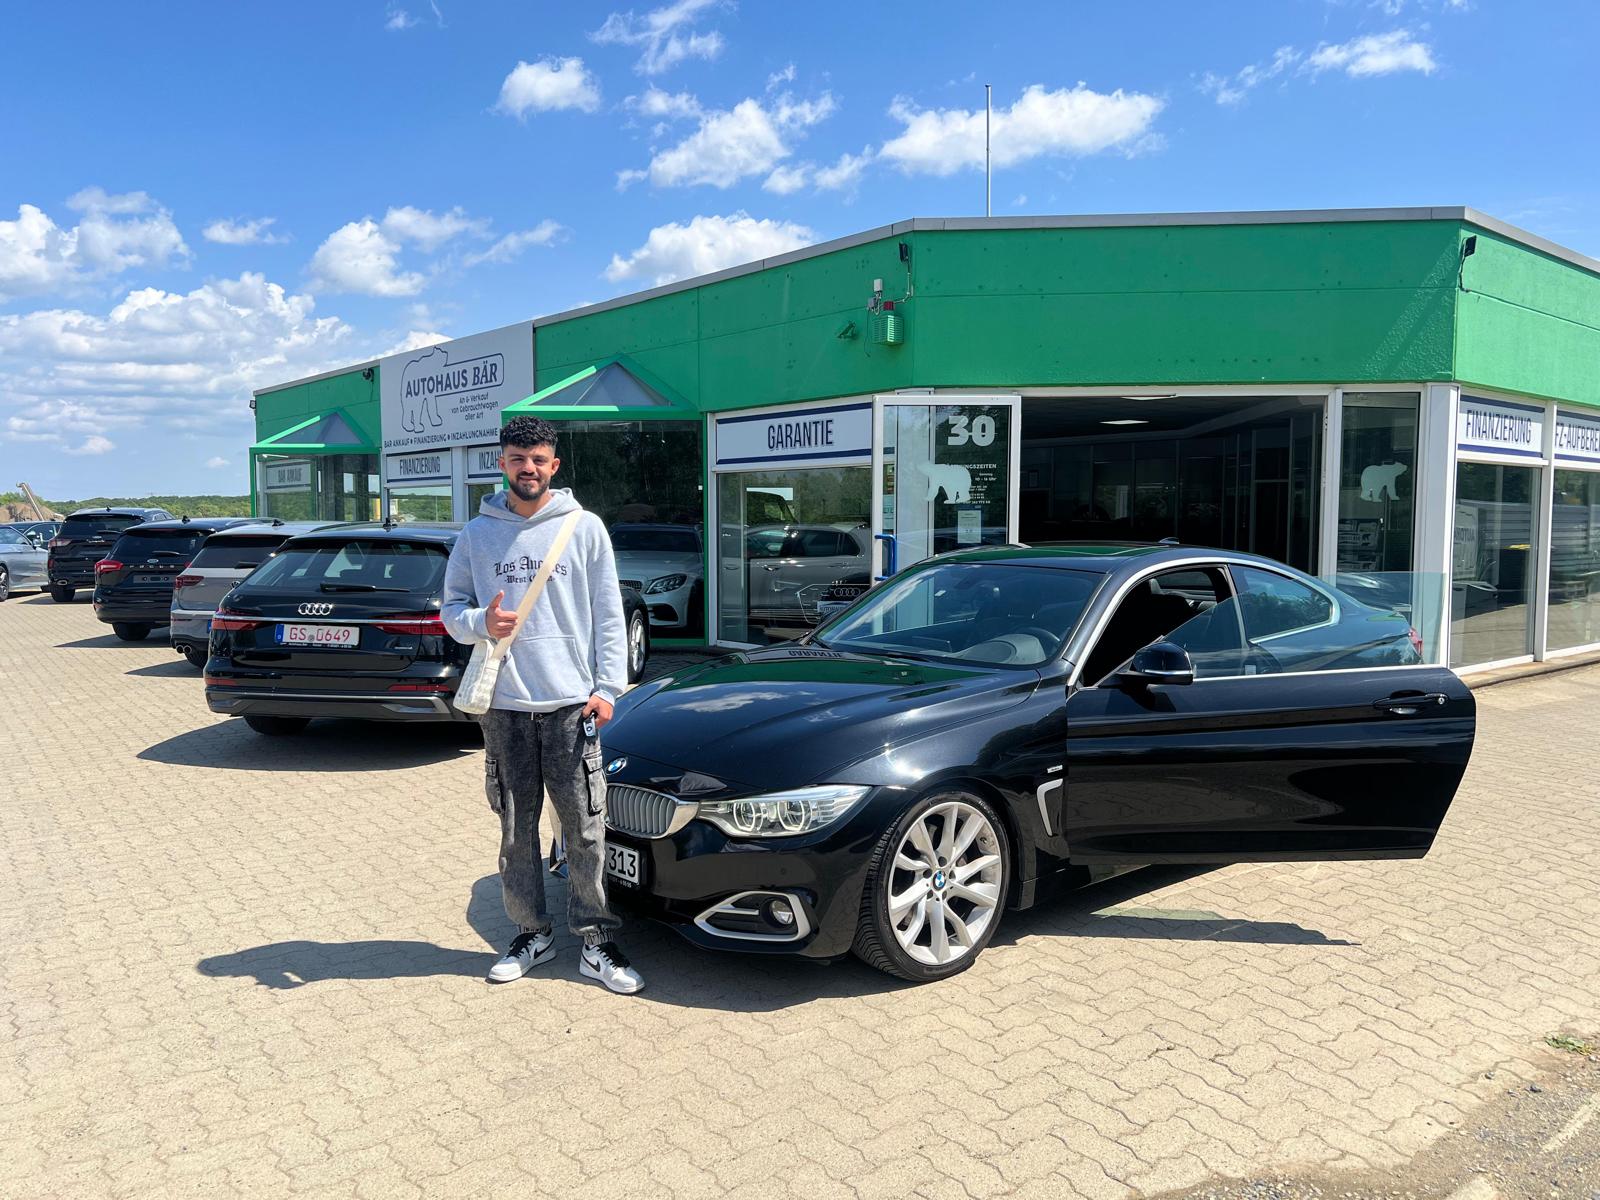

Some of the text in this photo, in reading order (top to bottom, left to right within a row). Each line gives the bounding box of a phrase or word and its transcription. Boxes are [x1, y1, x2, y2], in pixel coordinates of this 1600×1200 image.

[405, 360, 498, 399] AUTOHAUS BÄR
[460, 400, 499, 413] Gebrauchtwagen
[471, 391, 489, 402] Verkauf
[464, 413, 476, 421] aller
[1466, 409, 1532, 444] FINANZIERUNG
[384, 427, 499, 448] BAR ANKAUF FINANZIERUNG INZAHLUNGNAHME
[767, 419, 834, 450] GARANTIE
[947, 414, 996, 447] 30
[400, 456, 441, 476] FINANZIERUNG
[494, 560, 516, 577] Los
[289, 627, 307, 641] GS
[608, 847, 637, 878] 313
